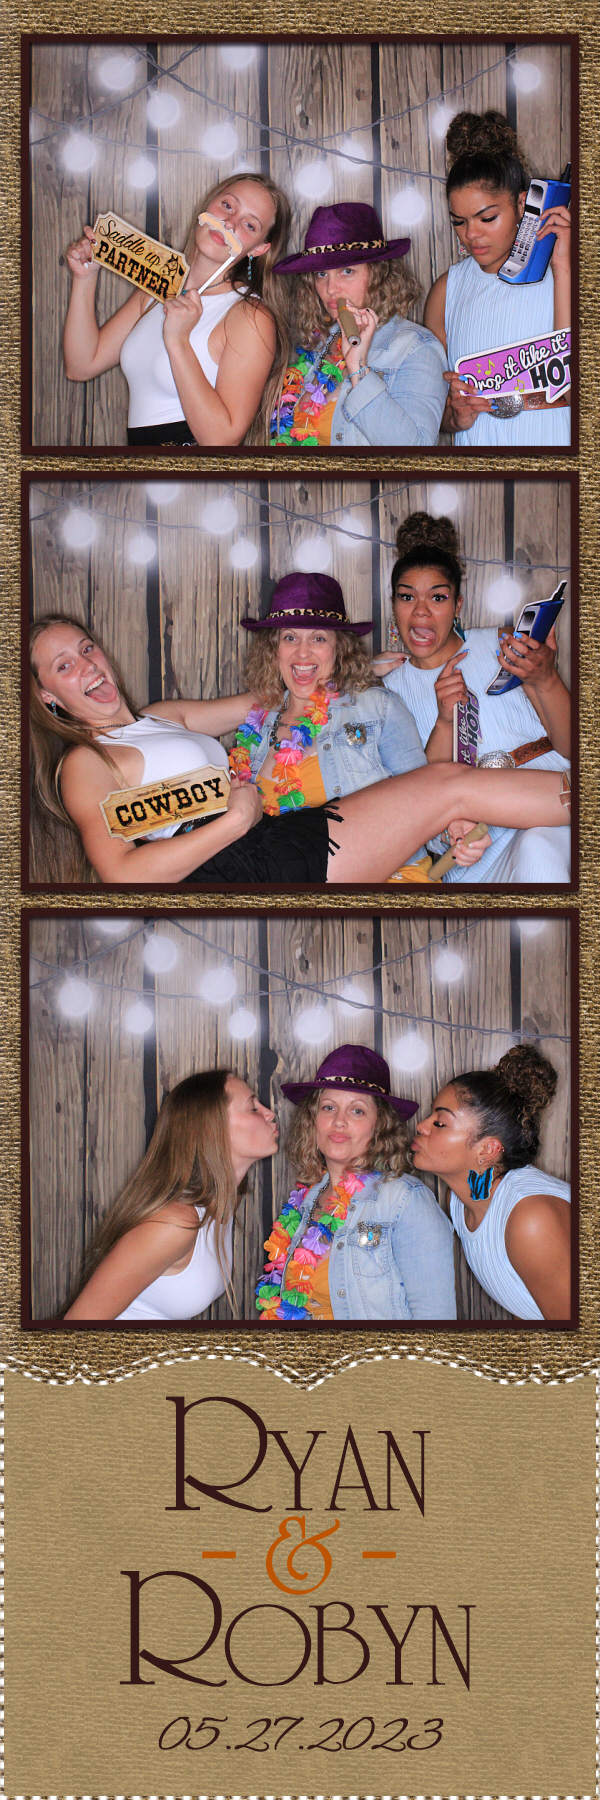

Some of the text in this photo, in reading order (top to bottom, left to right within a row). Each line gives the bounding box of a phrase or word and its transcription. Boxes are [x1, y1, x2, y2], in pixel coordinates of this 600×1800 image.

[99, 219, 161, 267] Saddle up
[95, 240, 170, 299] PARTNER
[503, 355, 521, 380] it
[519, 344, 551, 370] like
[467, 697, 479, 748] HOT
[115, 777, 224, 827] COWBOY
